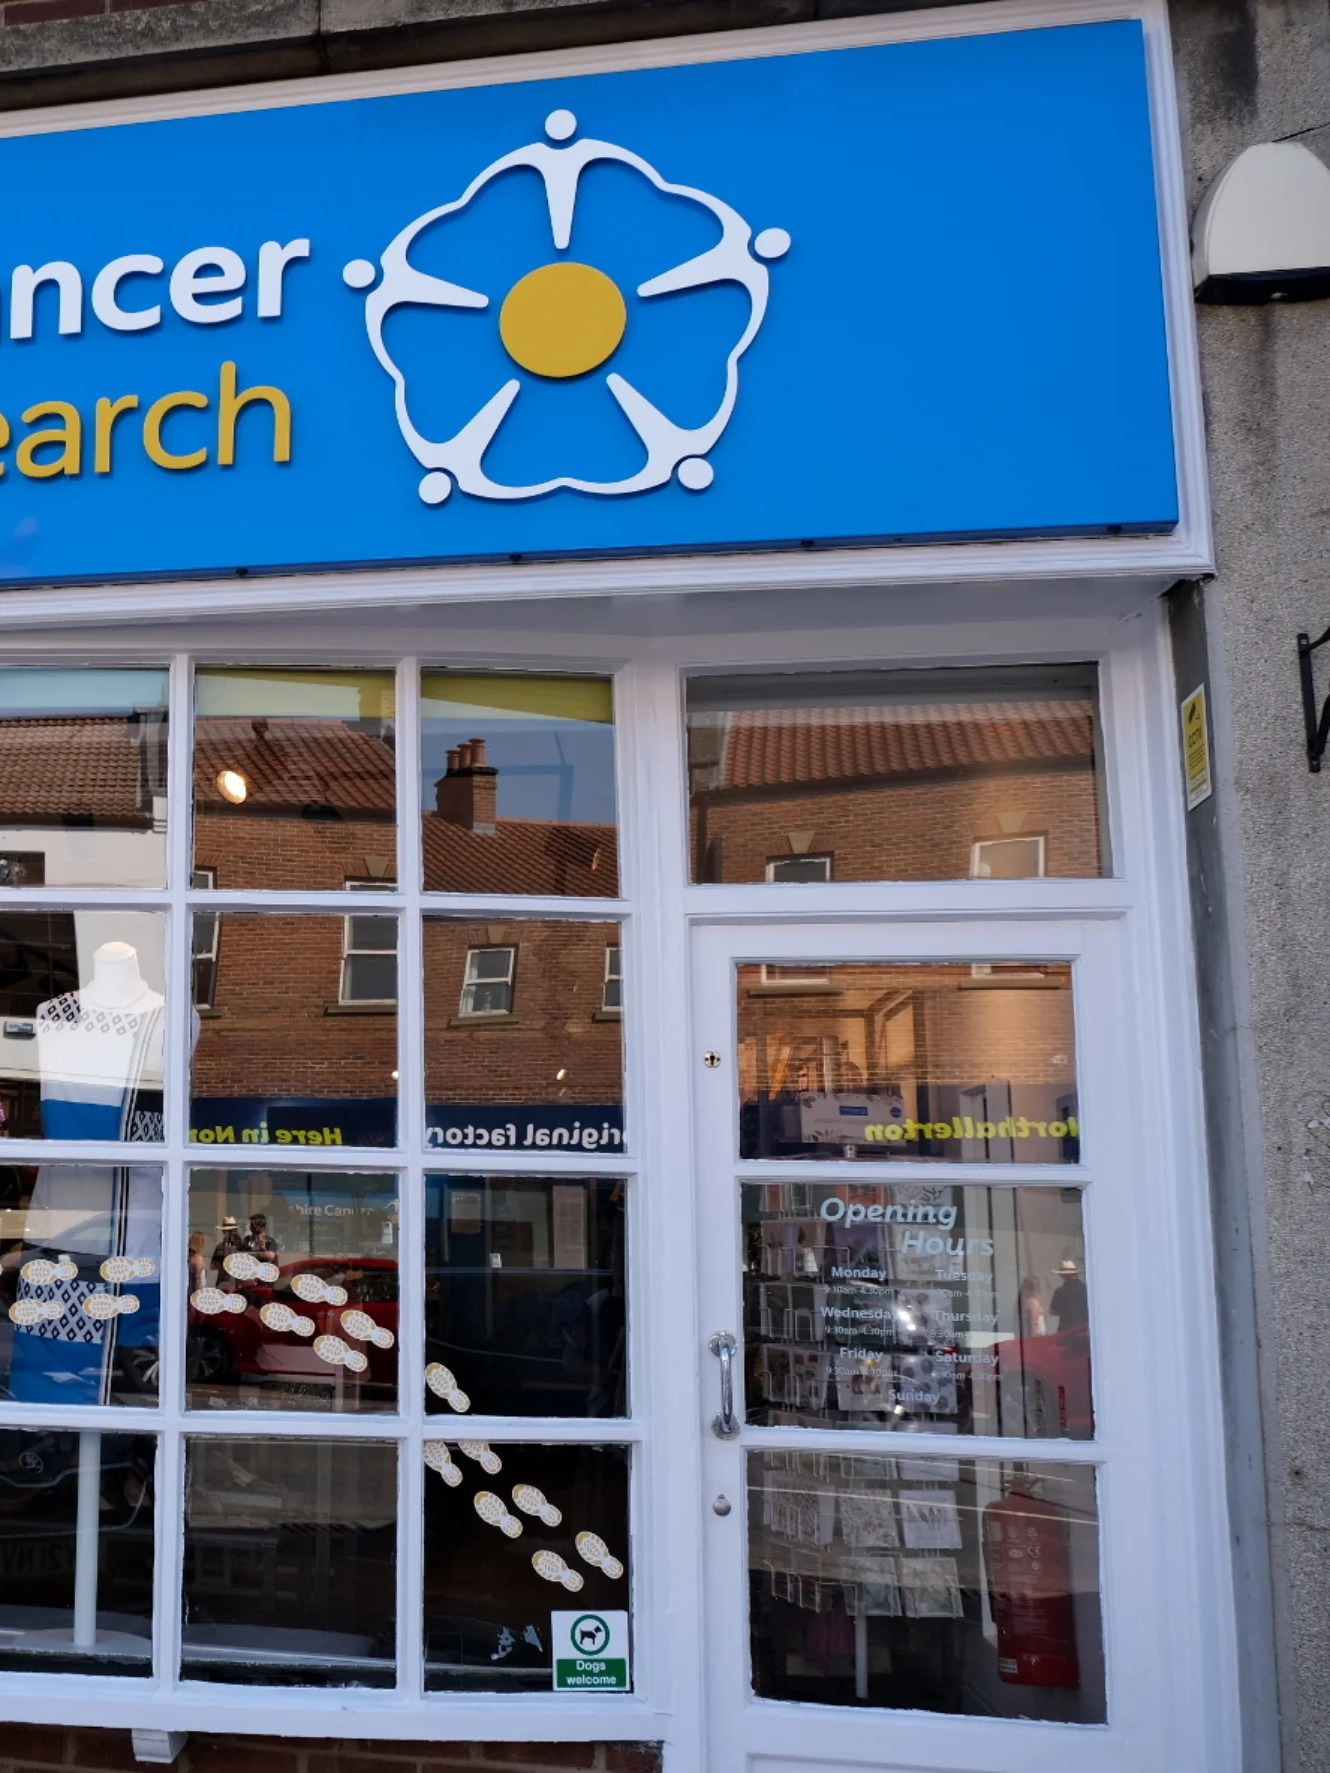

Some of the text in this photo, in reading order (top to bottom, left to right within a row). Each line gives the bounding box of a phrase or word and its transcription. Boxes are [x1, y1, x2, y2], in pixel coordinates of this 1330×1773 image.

[820, 1197, 958, 1230] Opening
[901, 1231, 995, 1257] Hours
[831, 1266, 887, 1281] Monday
[935, 1269, 993, 1284] Tuesday
[821, 1307, 898, 1322] Wednesday
[934, 1310, 999, 1326] Thursday
[839, 1346, 884, 1362] Friday
[935, 1350, 1000, 1366] Saturday
[887, 1389, 941, 1404] Sunday
[575, 1660, 606, 1674] Dogs
[566, 1674, 617, 1686] welcome
